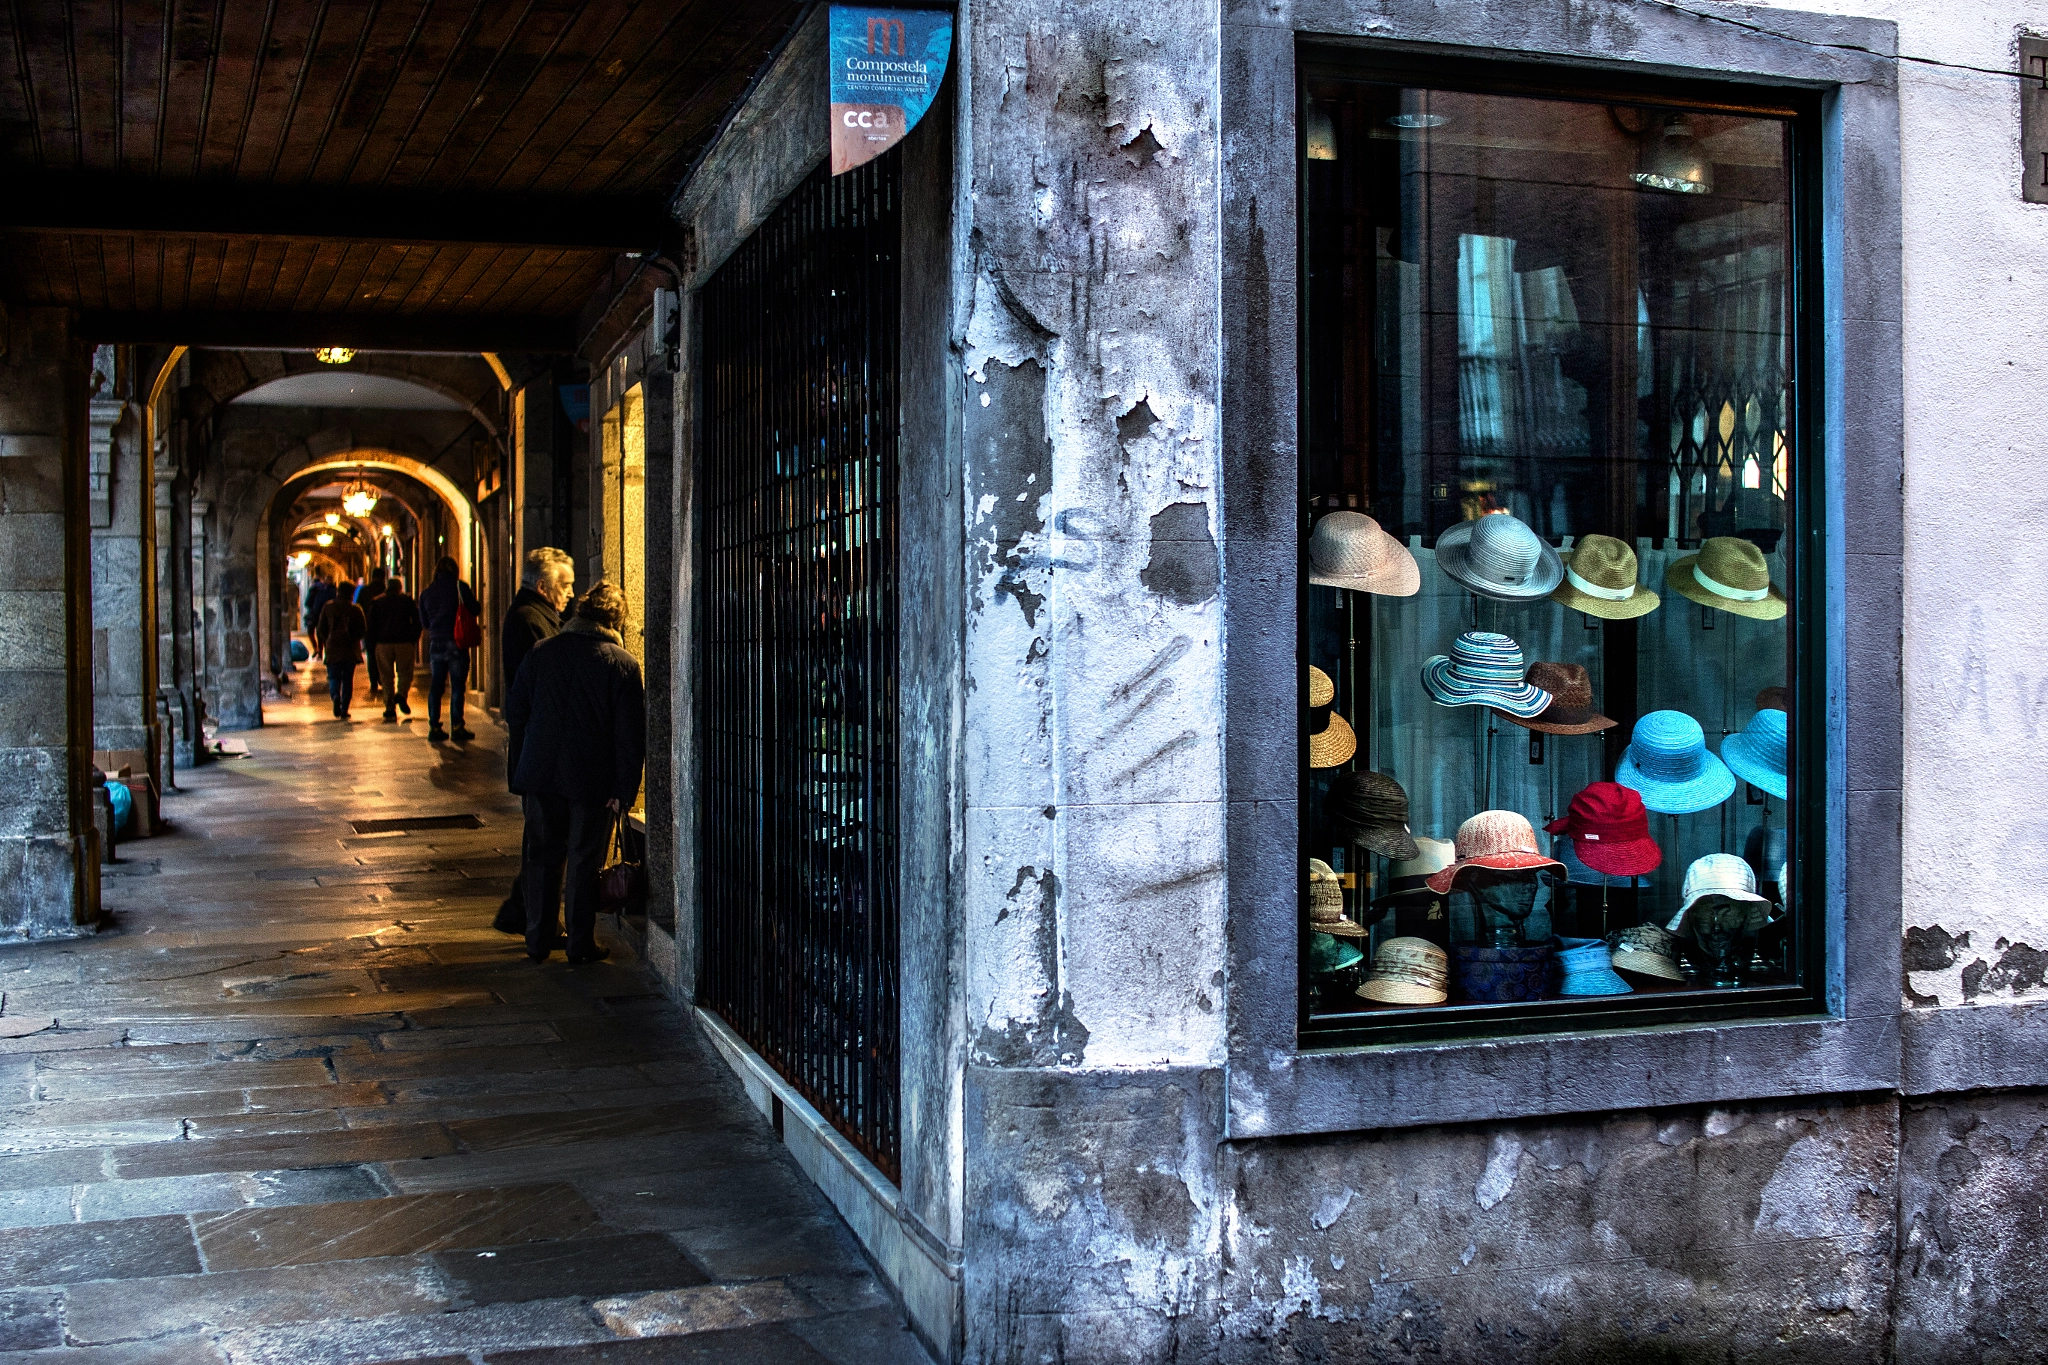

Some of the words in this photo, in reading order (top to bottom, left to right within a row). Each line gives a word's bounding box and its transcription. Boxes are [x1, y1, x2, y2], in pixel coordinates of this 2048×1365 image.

[846, 57, 928, 74] Compostela
[847, 73, 928, 85] monumental
[843, 110, 889, 128] cca
